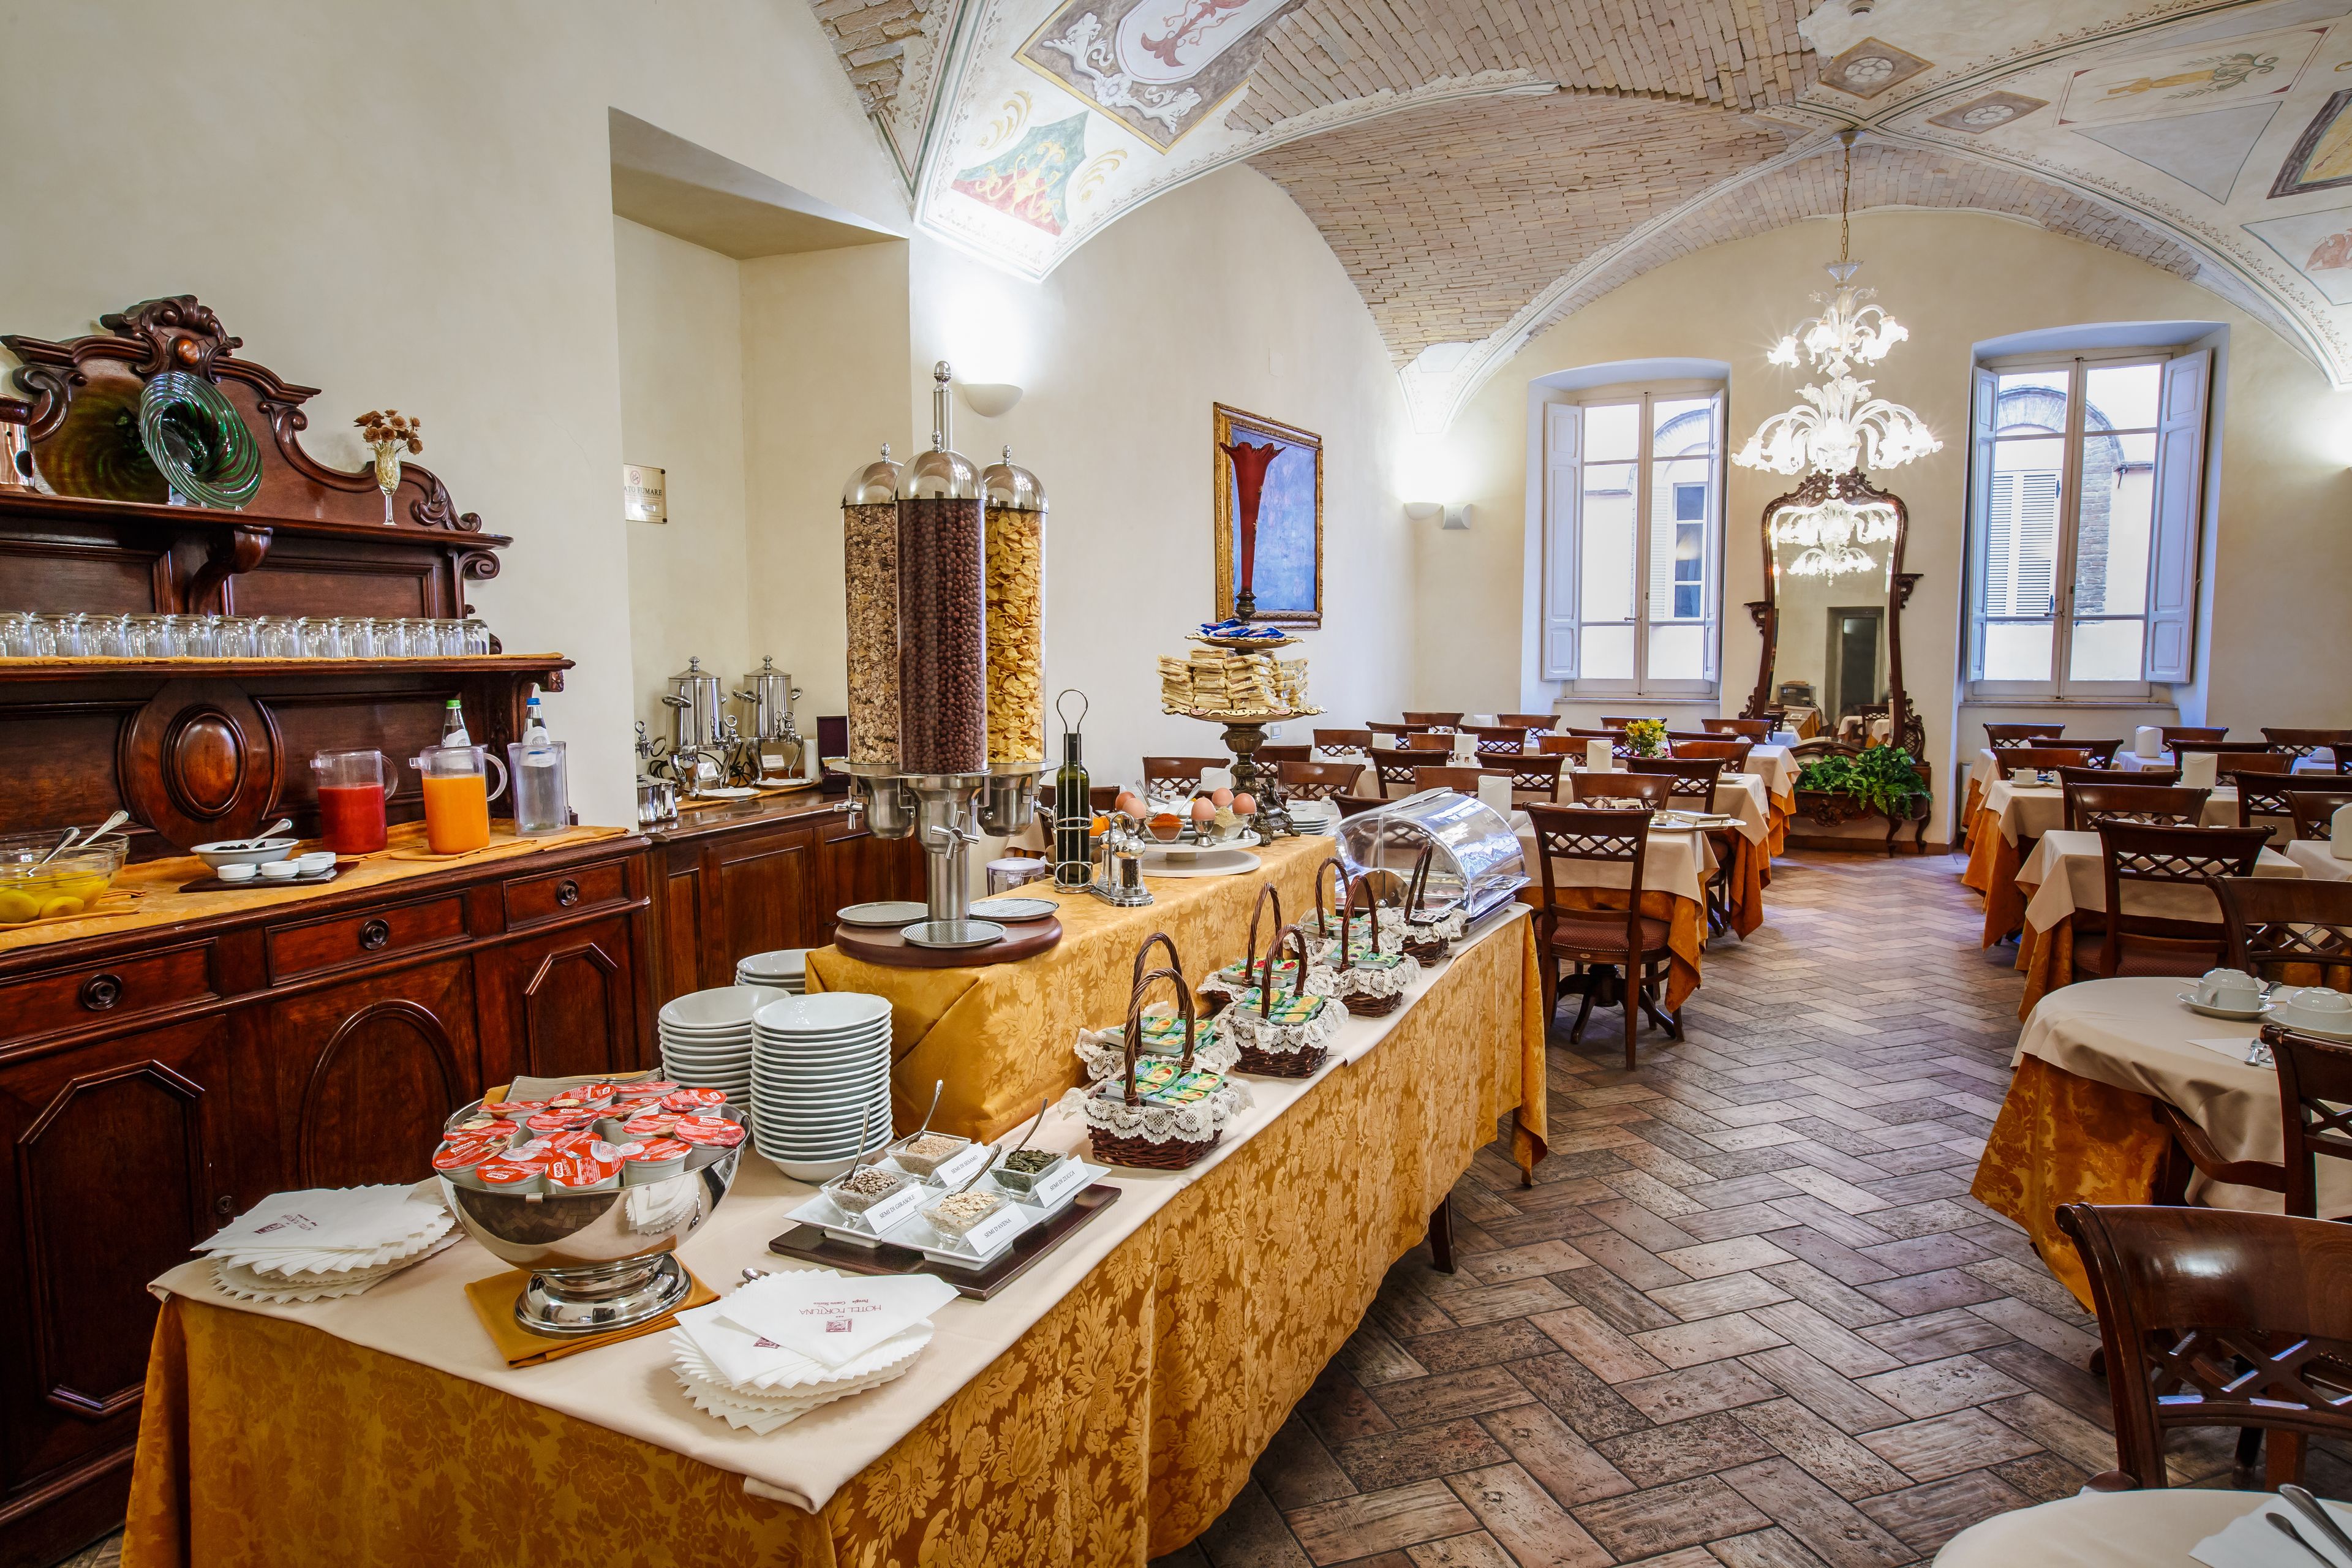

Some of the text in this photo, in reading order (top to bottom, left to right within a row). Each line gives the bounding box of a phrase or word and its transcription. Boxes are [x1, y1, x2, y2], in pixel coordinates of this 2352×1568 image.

[637, 487, 662, 496] FUMARE
[452, 1140, 475, 1152] YOMO
[951, 1166, 961, 1174] SEMI
[963, 1155, 978, 1166] SESAMO
[1049, 1182, 1060, 1191] SEMI
[1063, 1170, 1076, 1182] ZUCCA
[879, 1209, 891, 1219] SEMI
[895, 1194, 916, 1210] GIRASOLE
[984, 1218, 1012, 1238] SEMI D'AVENA
[799, 1306, 845, 1315] FORTUNA
